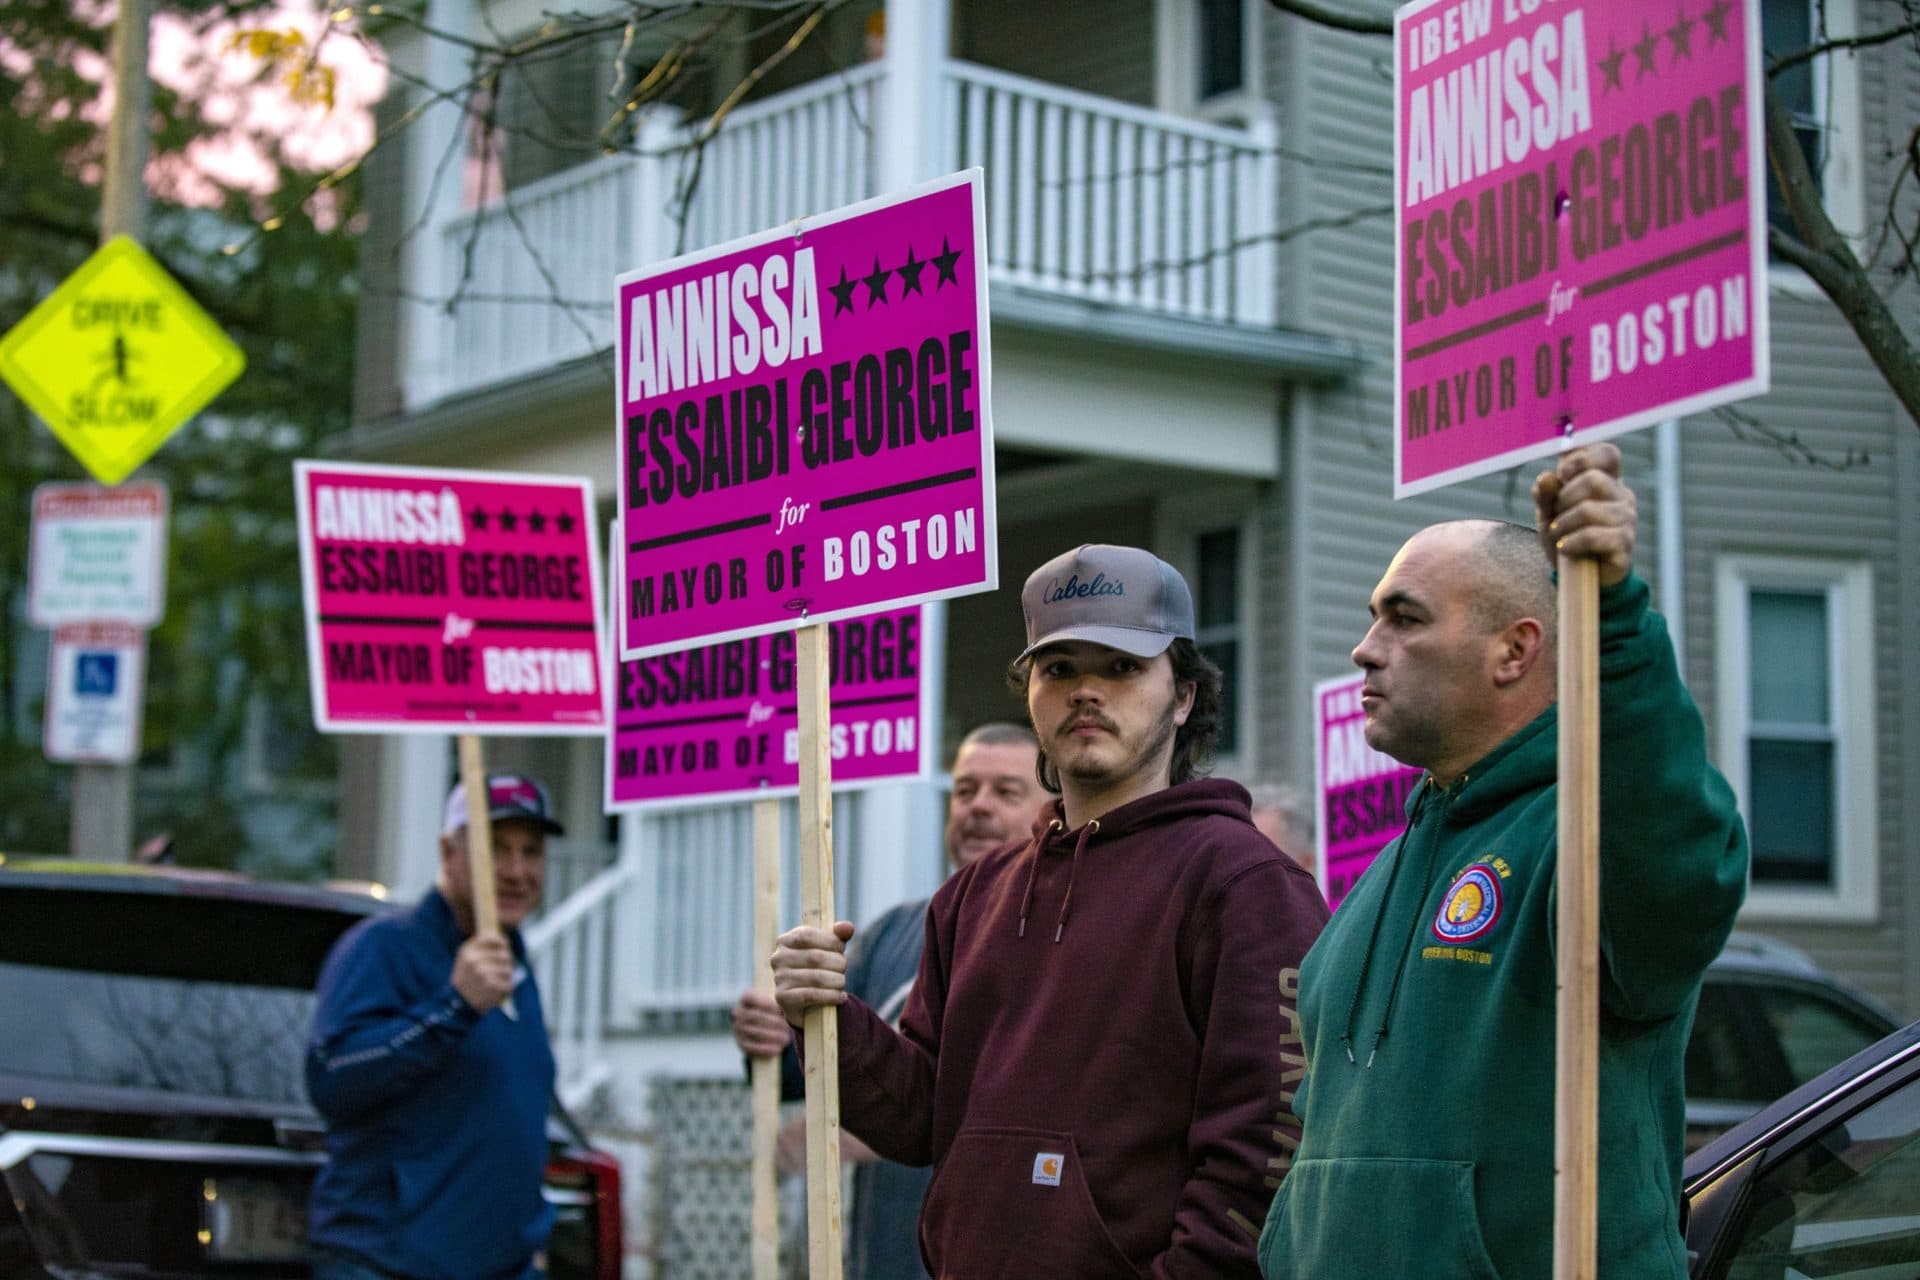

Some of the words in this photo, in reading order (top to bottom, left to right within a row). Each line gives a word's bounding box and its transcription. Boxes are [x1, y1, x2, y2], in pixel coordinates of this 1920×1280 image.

[1410, 0, 1492, 72] IBEW
[1406, 9, 1592, 207] ANNISSA
[1406, 160, 1559, 326] ESSAIBI
[1571, 83, 1745, 264] GEORGE
[72, 298, 163, 332] DRIVE
[628, 246, 823, 403] ANNISSA
[1545, 280, 1578, 326] for
[1407, 356, 1516, 441] MAYOR
[1535, 335, 1574, 398] OF
[1590, 274, 1747, 383] BOSTON
[67, 393, 159, 428] SLOW
[628, 378, 789, 510] ESSAIBI
[801, 330, 975, 471] GEORGE
[316, 486, 465, 546] ANNISSA
[776, 497, 810, 535] for
[321, 546, 449, 596] ESSAIBI
[460, 551, 583, 601] GEORGE
[631, 557, 748, 620] MAYOR
[766, 544, 806, 593] OF
[824, 507, 976, 582] BOSTON
[1044, 571, 1124, 605] Cabela's
[442, 612, 475, 645] for
[329, 642, 433, 685] MAYOR
[442, 644, 474, 686] OF
[483, 646, 596, 694] BOSTON
[620, 632, 758, 711] ESSAIBI
[770, 615, 917, 694] GRGE
[747, 701, 775, 727] for
[618, 739, 719, 780] MAYOR
[735, 734, 771, 767] OF
[784, 716, 916, 764] BSTON
[1329, 770, 1422, 846] ESSAI
